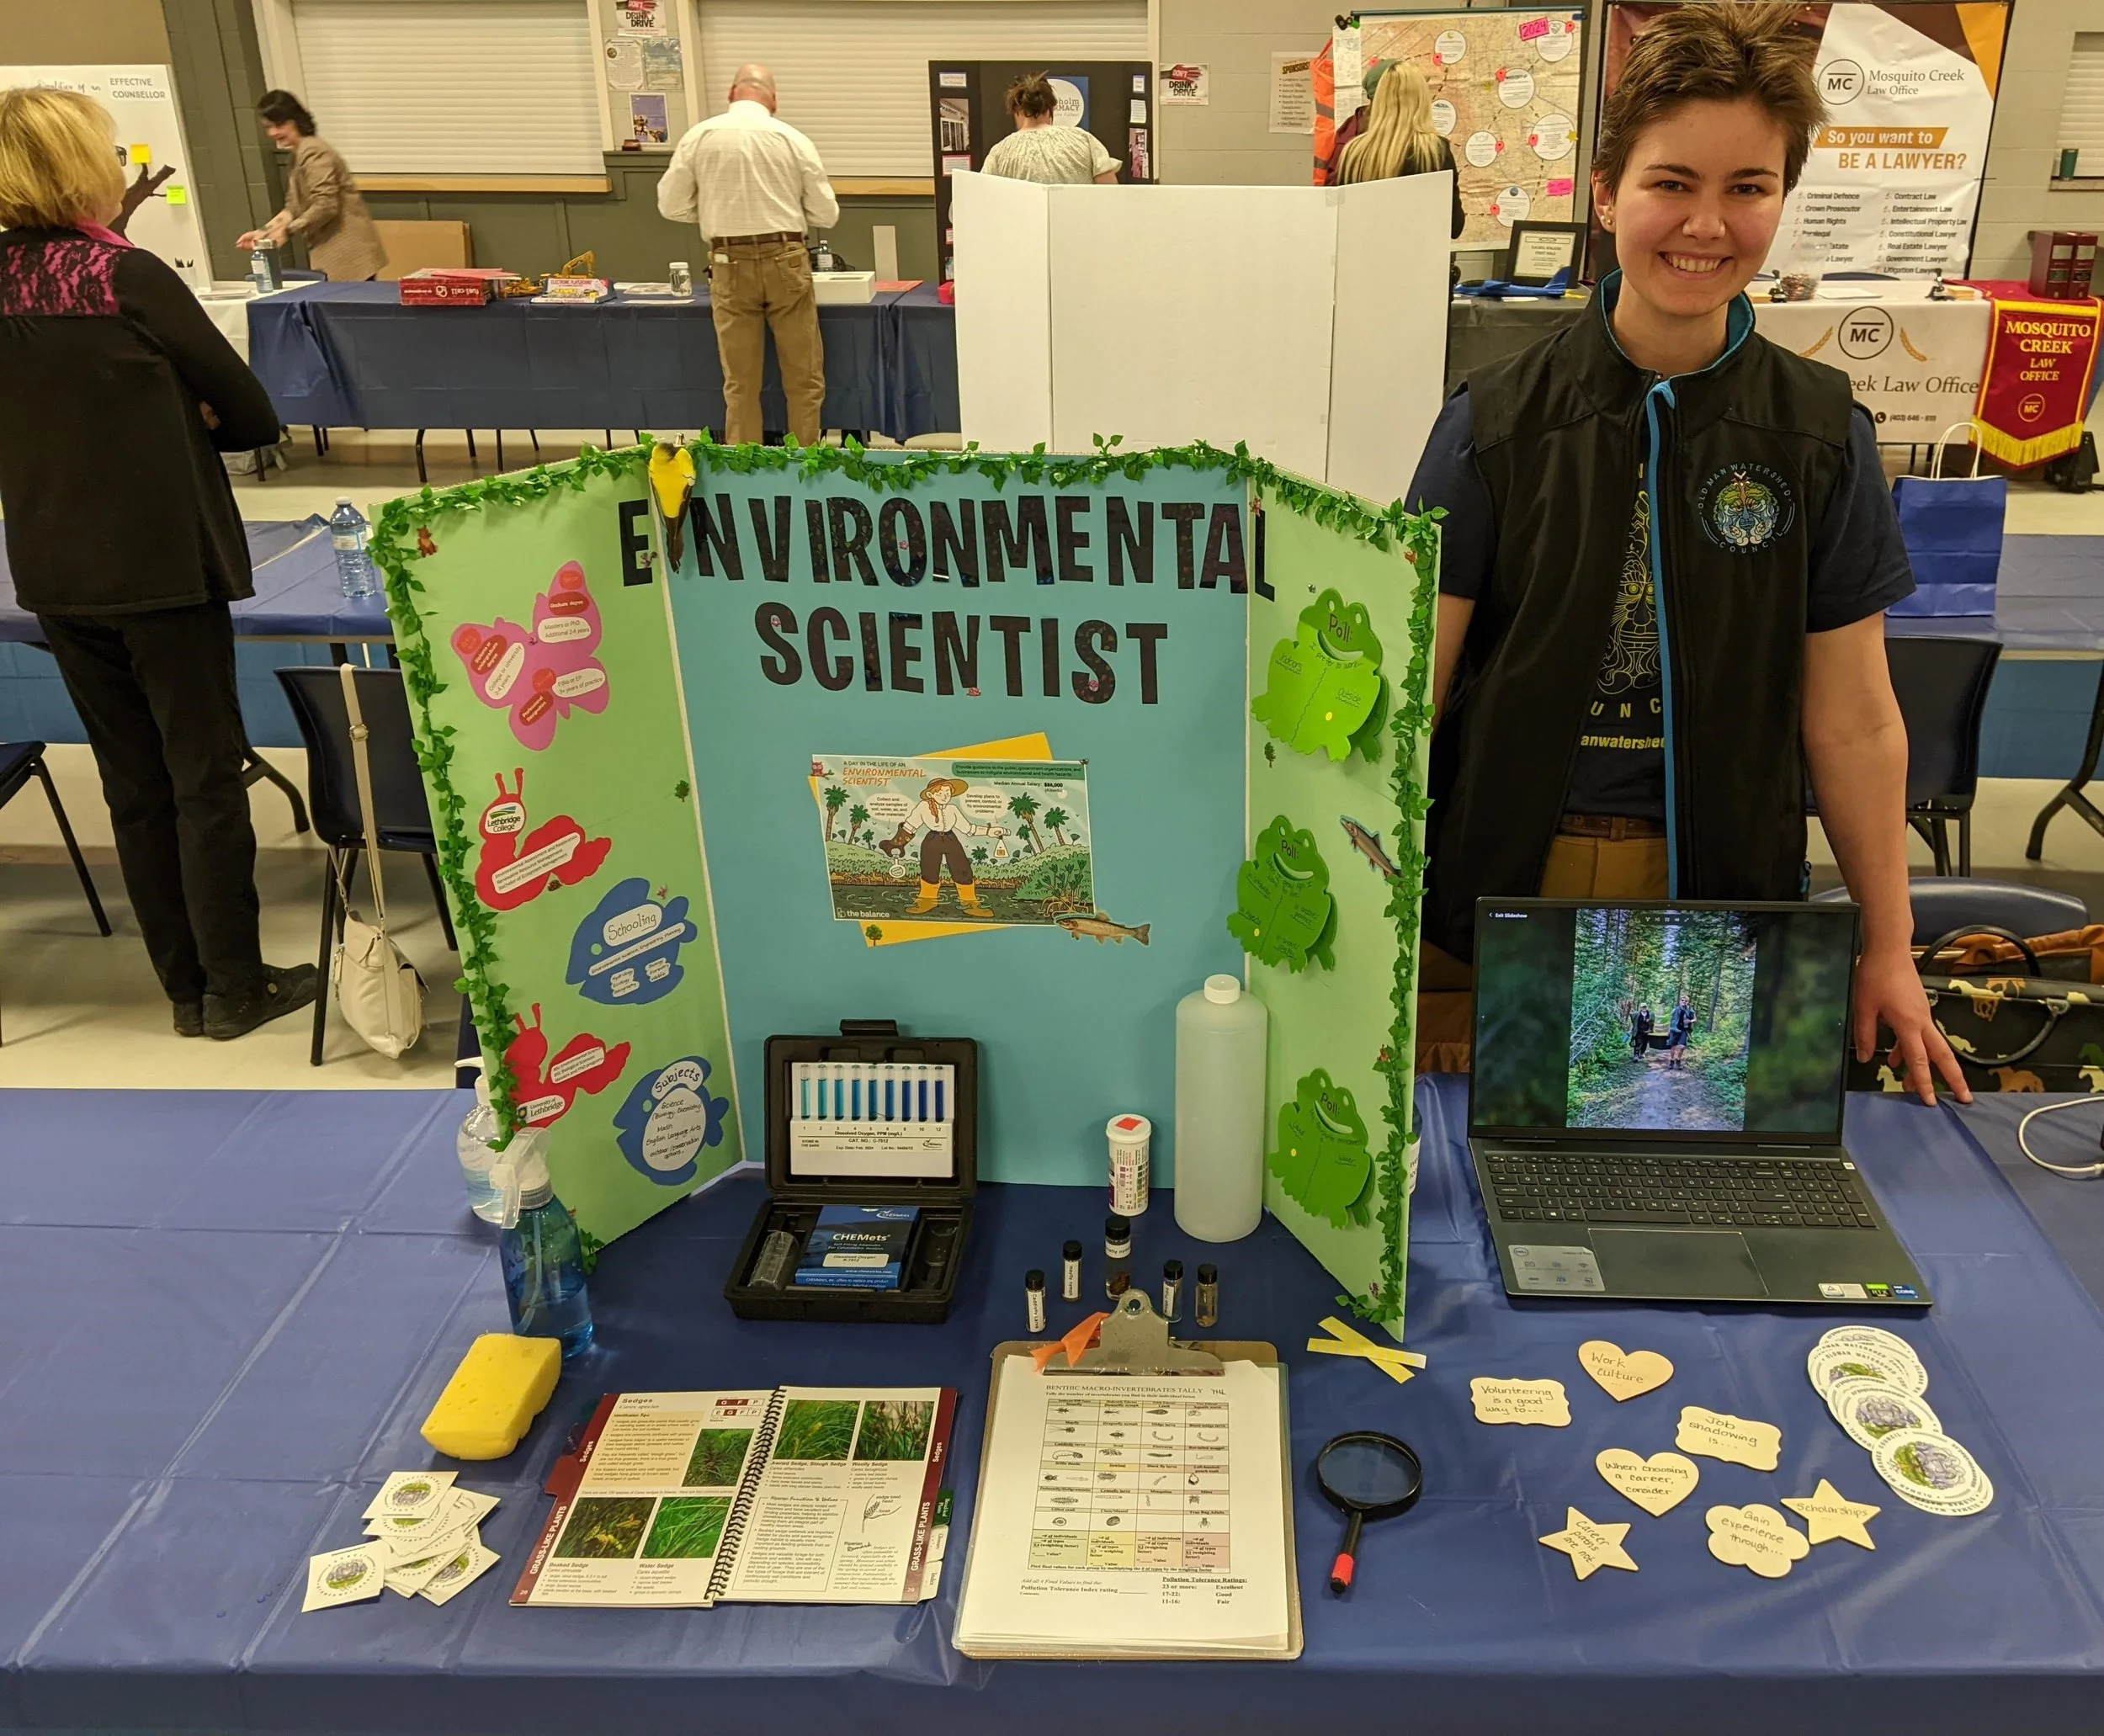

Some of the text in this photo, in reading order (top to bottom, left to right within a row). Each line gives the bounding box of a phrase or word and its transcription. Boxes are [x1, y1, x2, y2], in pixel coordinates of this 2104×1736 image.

[1522, 21, 1547, 37] 2024
[1828, 78, 1852, 90] MC
[1869, 69, 1965, 84] Mosquito Creek
[1868, 86, 1919, 94] Law Office
[1828, 130, 1932, 146] So you want to
[1839, 153, 1967, 169] BE A LAWYER?
[1850, 329, 1880, 342] MC
[2006, 321, 2091, 337] MOSQUITO
[2020, 340, 2072, 353] CREEK
[2030, 358, 2056, 368] LAW
[2020, 370, 2060, 381] OFFICE
[1850, 375, 1978, 394] eek Law Office
[1730, 464, 1791, 496] WATERSHED
[619, 495, 1275, 603] ENVIRONMENTAL
[1719, 532, 1783, 553] COUNCIL
[1329, 613, 1352, 643] Poll:
[755, 602, 1167, 704] SCIENTIST
[843, 767, 927, 778] ENVIRONMENTAL
[842, 778, 890, 786] SCIENTIST
[487, 815, 520, 827] Lethbridge
[493, 824, 515, 832] College
[1281, 840, 1299, 861] Poll:
[608, 913, 656, 940] Schooling
[656, 1068, 700, 1093] Subjects
[530, 1101, 563, 1117] Lethbridge
[661, 1099, 684, 1109] Science
[1320, 1092, 1340, 1117] Poll:
[646, 1136, 666, 1146] English
[1591, 1352, 1626, 1368] Work
[1597, 1367, 1644, 1383] culture
[1481, 1386, 1554, 1400] Volunteering
[1517, 1397, 1543, 1407] good
[1485, 1406, 1509, 1415] way
[1705, 1416, 1735, 1430] Job
[1689, 1422, 1757, 1447] shadowing
[579, 1441, 594, 1463] Sedges
[932, 1441, 943, 1463] Sedges
[1605, 1463, 1688, 1479] When choosing
[1626, 1486, 1672, 1494] consider
[1797, 1503, 1868, 1517] Scholarships
[1744, 1511, 1770, 1526] Gain
[911, 1501, 930, 1571] GRASS-LIKE PLANTS
[1576, 1521, 1610, 1546] Career
[1721, 1517, 1784, 1543] experience
[529, 1505, 567, 1574] GRASS-LIKE PLANTS
